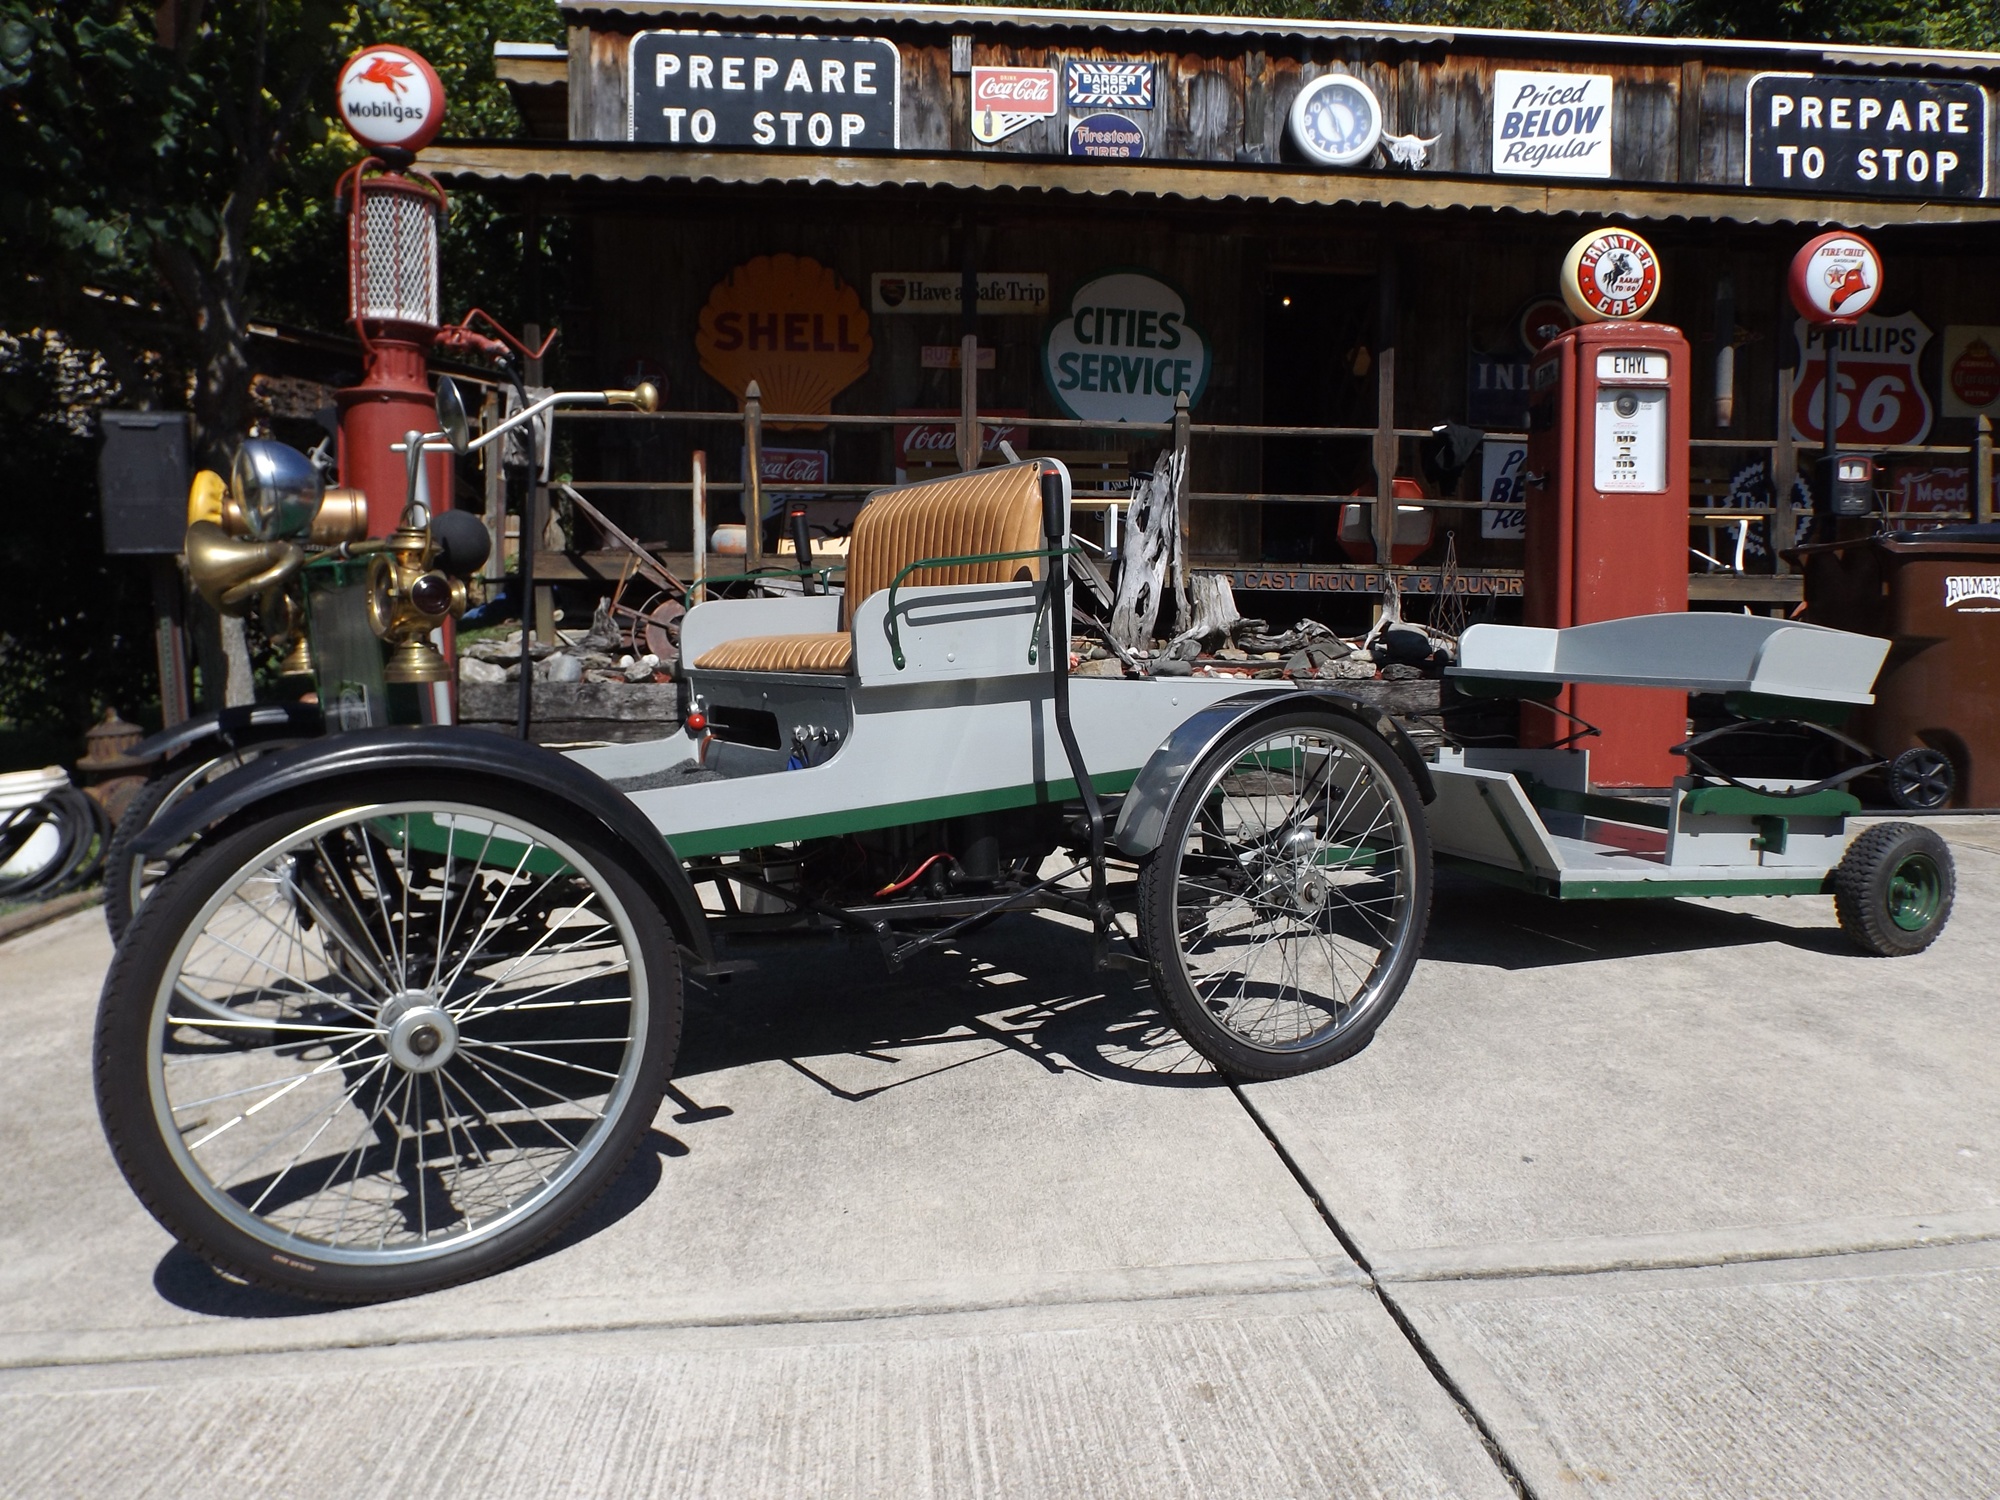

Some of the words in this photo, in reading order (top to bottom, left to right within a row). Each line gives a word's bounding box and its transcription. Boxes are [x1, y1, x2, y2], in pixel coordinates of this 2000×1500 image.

[656, 53, 877, 95] PREPARE
[1083, 74, 1136, 85] BARBER
[978, 77, 1051, 101] Coca-Cola
[1092, 84, 1128, 95] SHOP
[1512, 79, 1592, 109] Priced
[348, 101, 423, 123] Mobilgas
[1304, 115, 1312, 126] 9
[1310, 102, 1321, 113] 10
[1771, 94, 1969, 134] PREPARE
[662, 107, 717, 143] TO
[752, 111, 866, 147] STOP
[1074, 126, 1141, 145] Firestone
[1500, 105, 1605, 140] BELOW
[1084, 146, 1130, 157] TIRES
[1503, 137, 1602, 168] Regular
[1777, 145, 1825, 179] TO
[1856, 148, 1959, 183] STOP
[1581, 235, 1653, 269] FRONTIER
[909, 282, 951, 301] Have
[976, 281, 1006, 301] afe
[1007, 281, 1046, 306] Trip
[1596, 296, 1638, 315] GAS
[713, 311, 860, 353] SHELL
[1073, 306, 1181, 350] CITIES
[1057, 351, 1192, 397] SERVICE
[1614, 357, 1649, 374] ETHYL
[1808, 372, 1906, 434] 66
[1244, 571, 1298, 590] CAST
[1308, 573, 1356, 591] IRON
[1418, 575, 1432, 592] &
[1443, 575, 1525, 595] FOUNDR
